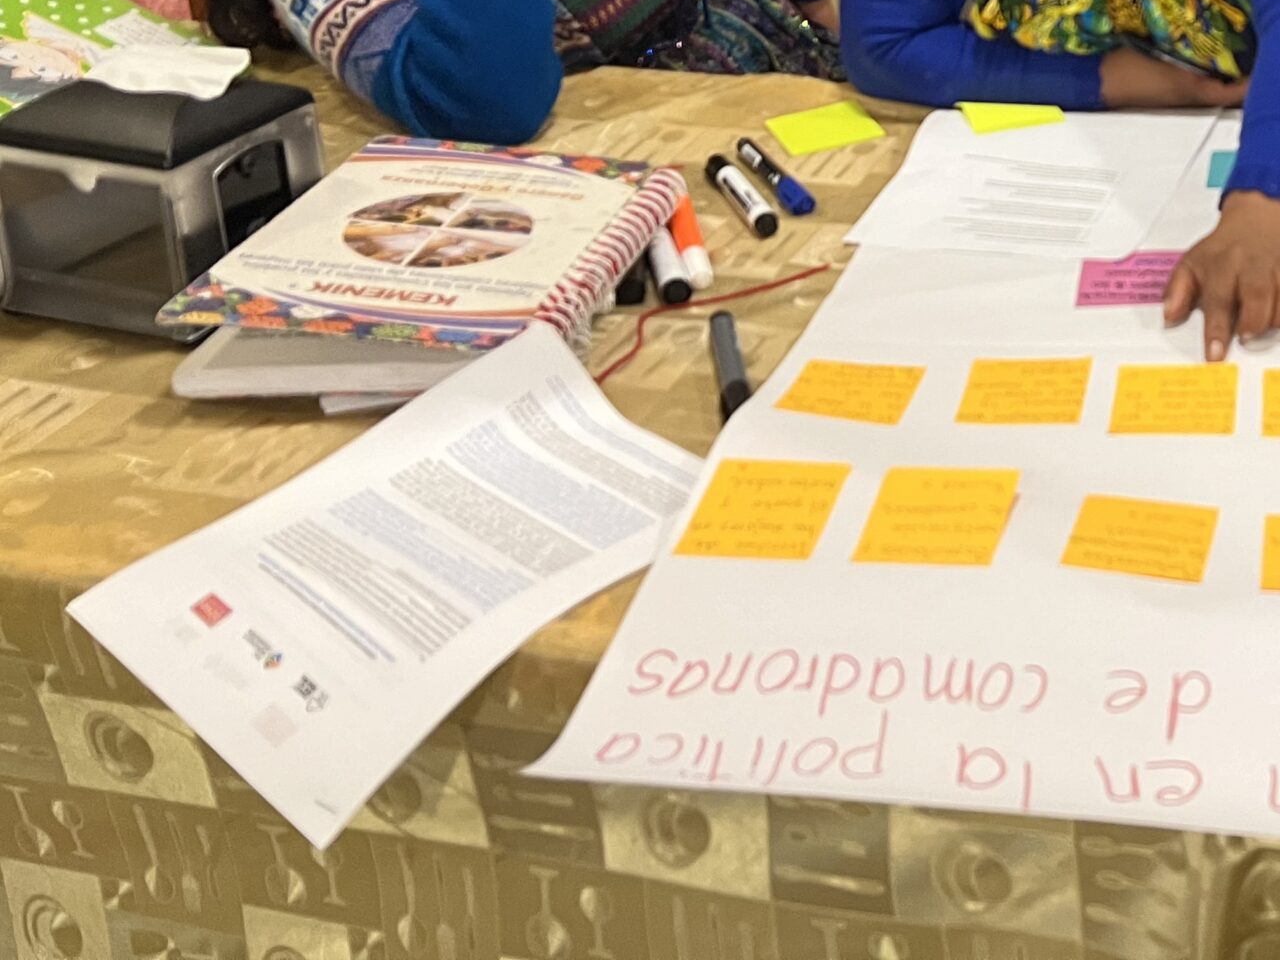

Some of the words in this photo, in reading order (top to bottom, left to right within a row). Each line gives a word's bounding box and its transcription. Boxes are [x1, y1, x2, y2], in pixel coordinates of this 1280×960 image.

[312, 280, 458, 306] KEMENIK
[626, 647, 1049, 718] comadronas
[1103, 668, 1213, 742] de
[956, 742, 1032, 813] la
[1094, 756, 1203, 808] en
